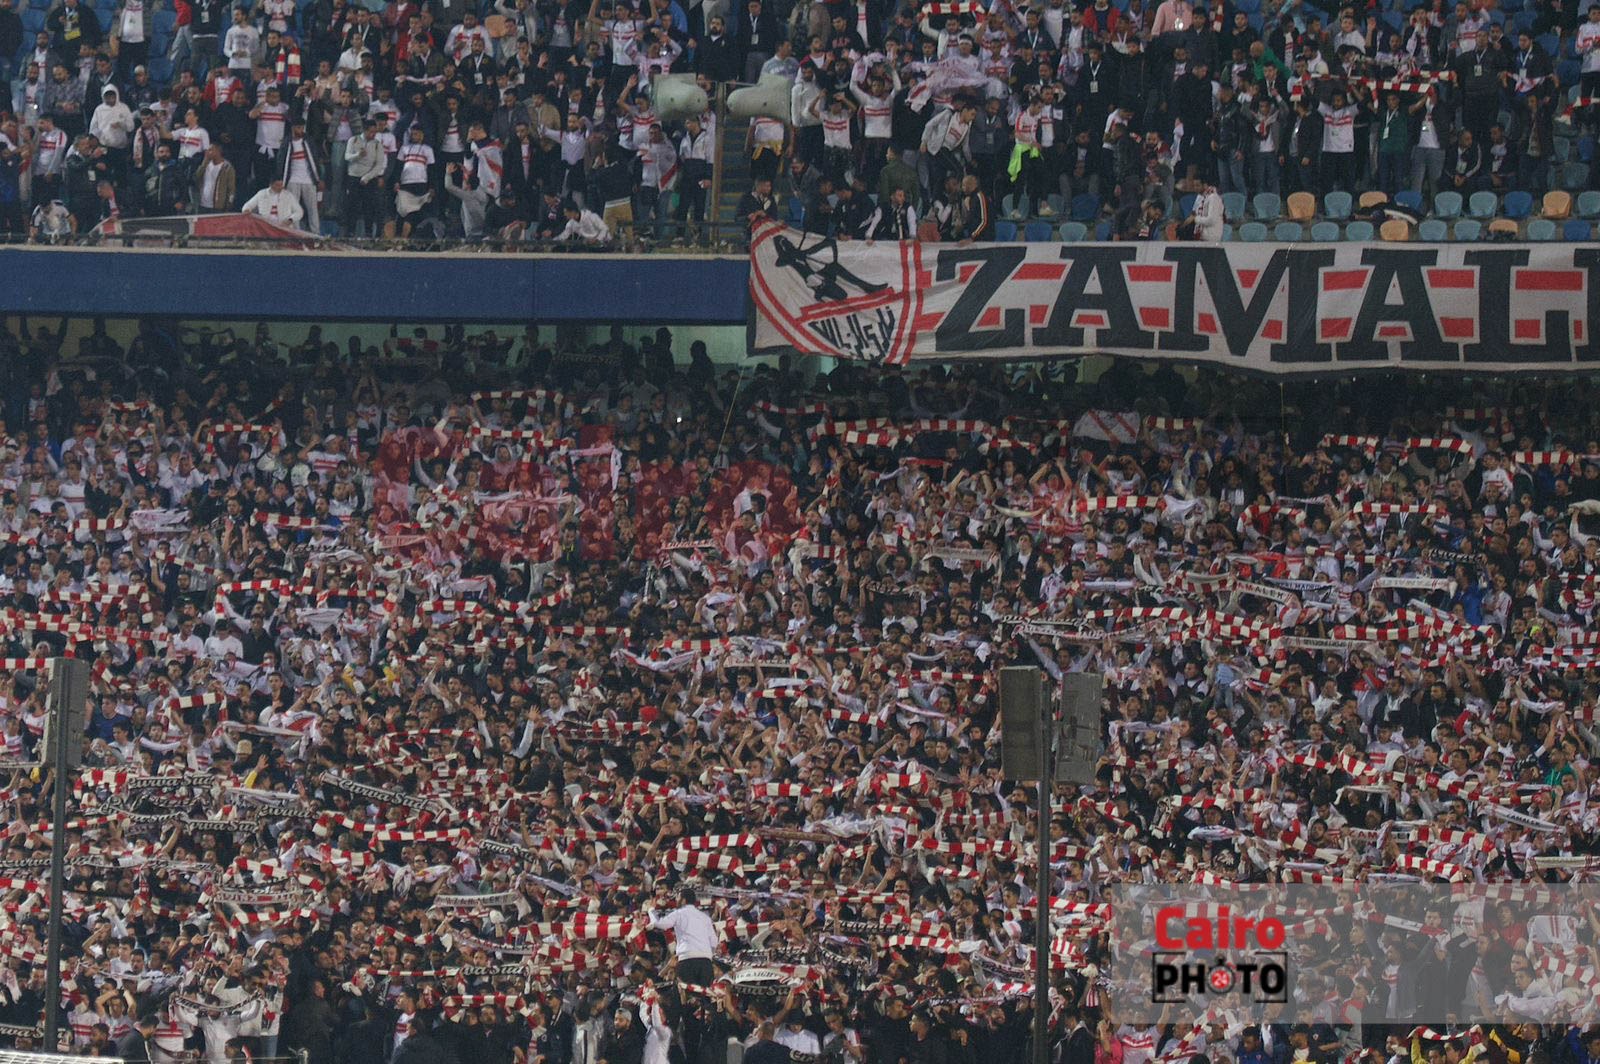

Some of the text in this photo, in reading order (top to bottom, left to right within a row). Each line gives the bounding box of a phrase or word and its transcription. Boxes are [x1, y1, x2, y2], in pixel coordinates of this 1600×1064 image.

[936, 246, 1600, 362] ZAMAL
[1237, 582, 1284, 600] AMALEK
[338, 777, 429, 810] Curva Sud
[259, 805, 311, 818] Curva
[766, 986, 788, 996] Su
